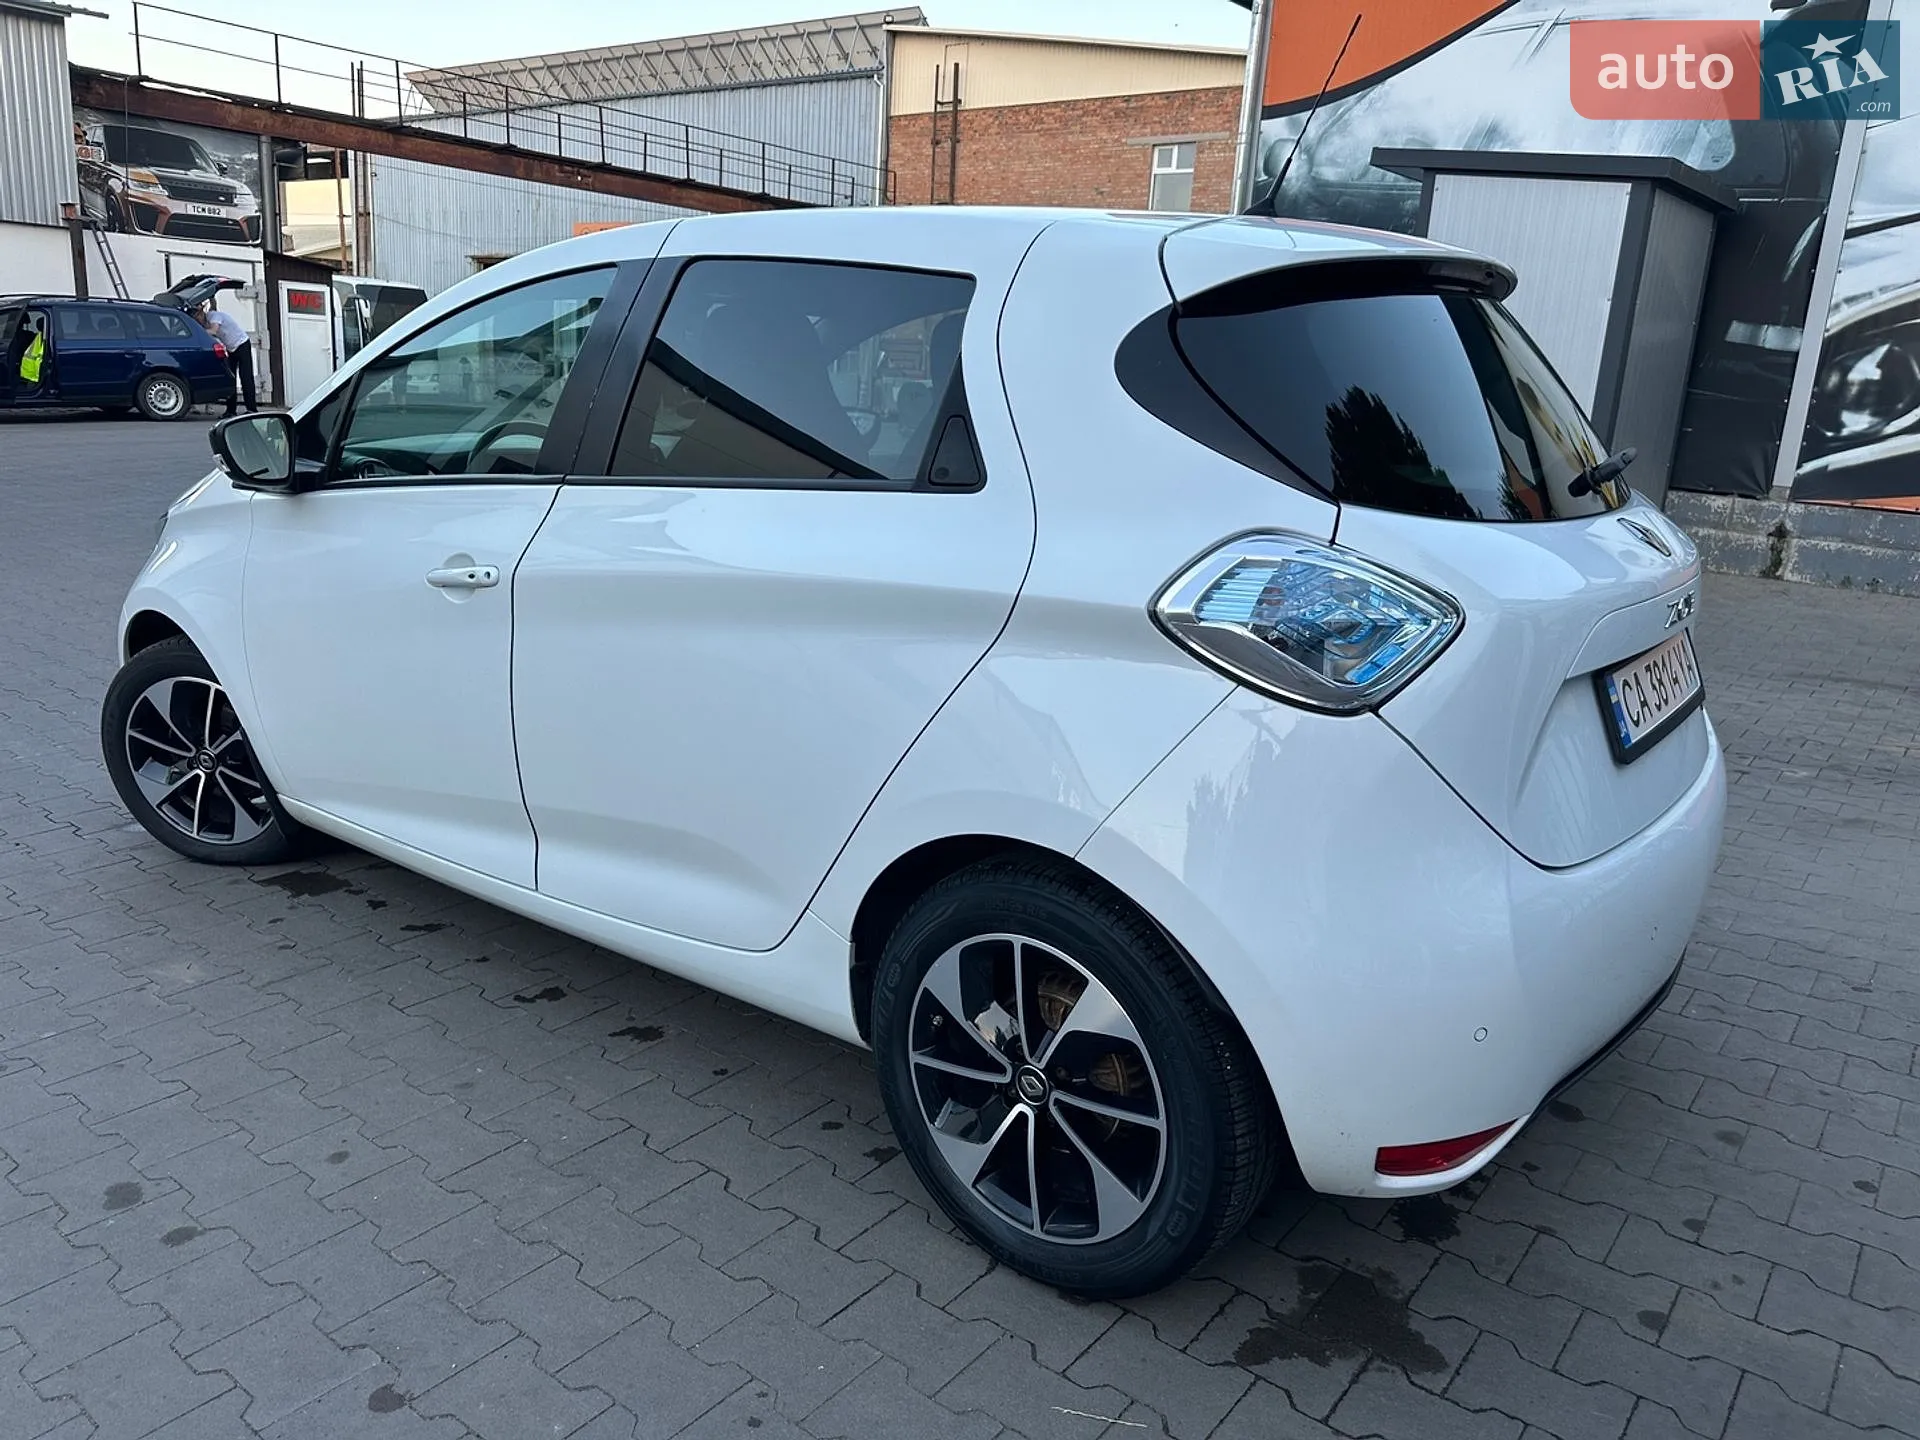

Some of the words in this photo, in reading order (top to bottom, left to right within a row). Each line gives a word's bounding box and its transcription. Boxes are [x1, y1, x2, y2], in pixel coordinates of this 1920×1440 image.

[291, 292, 323, 309] WC
[1622, 672, 1653, 728] CA
[1645, 650, 1683, 712] 3814
